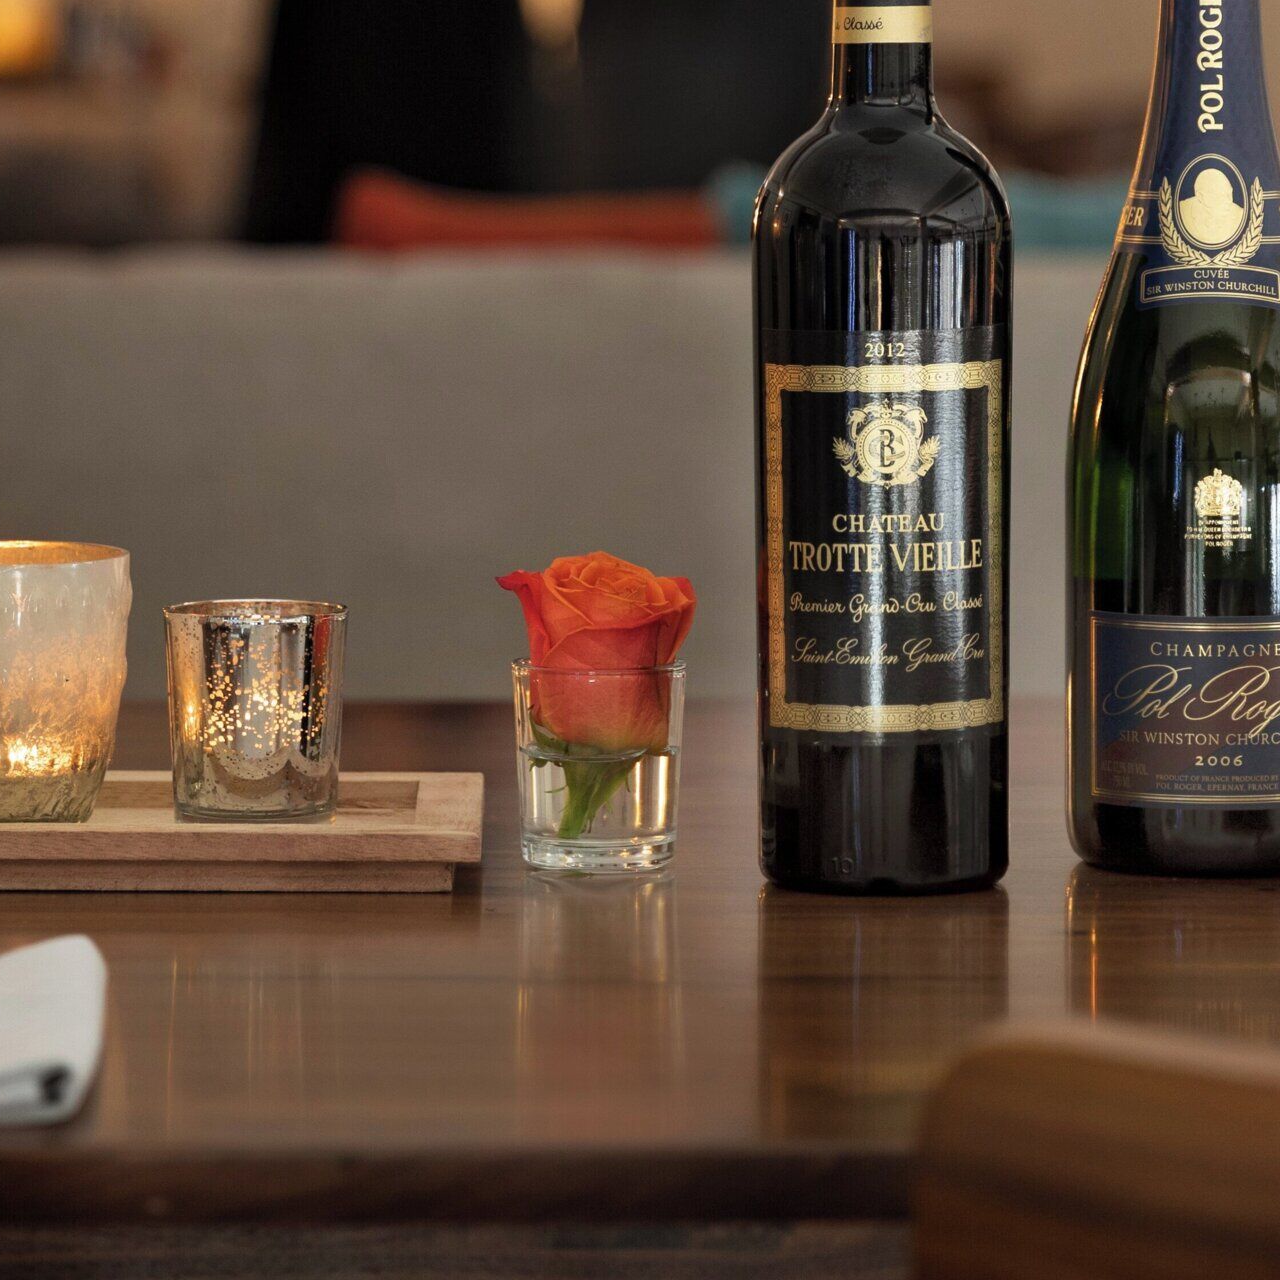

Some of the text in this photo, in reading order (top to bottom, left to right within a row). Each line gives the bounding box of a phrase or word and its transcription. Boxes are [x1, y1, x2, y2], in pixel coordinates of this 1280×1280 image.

[843, 17, 884, 31] Classé
[1197, 74, 1224, 134] POL
[1193, 268, 1230, 279] CUVÉE
[1146, 281, 1277, 296] SIR WINSTON CHURCHILL
[864, 342, 905, 358] 2012
[789, 539, 983, 573] TROTTE VIEILLE
[790, 592, 846, 613] Premier
[942, 591, 984, 611] Classé
[902, 637, 965, 672] Grand
[961, 633, 984, 659] Cru
[1102, 664, 1193, 720] Pol
[1120, 731, 1141, 744] SIR
[1144, 732, 1220, 746] WINSTON
[1195, 755, 1243, 767] 2006
[1155, 774, 1188, 782] PRODUCT
[1247, 782, 1279, 791] FRANCE
